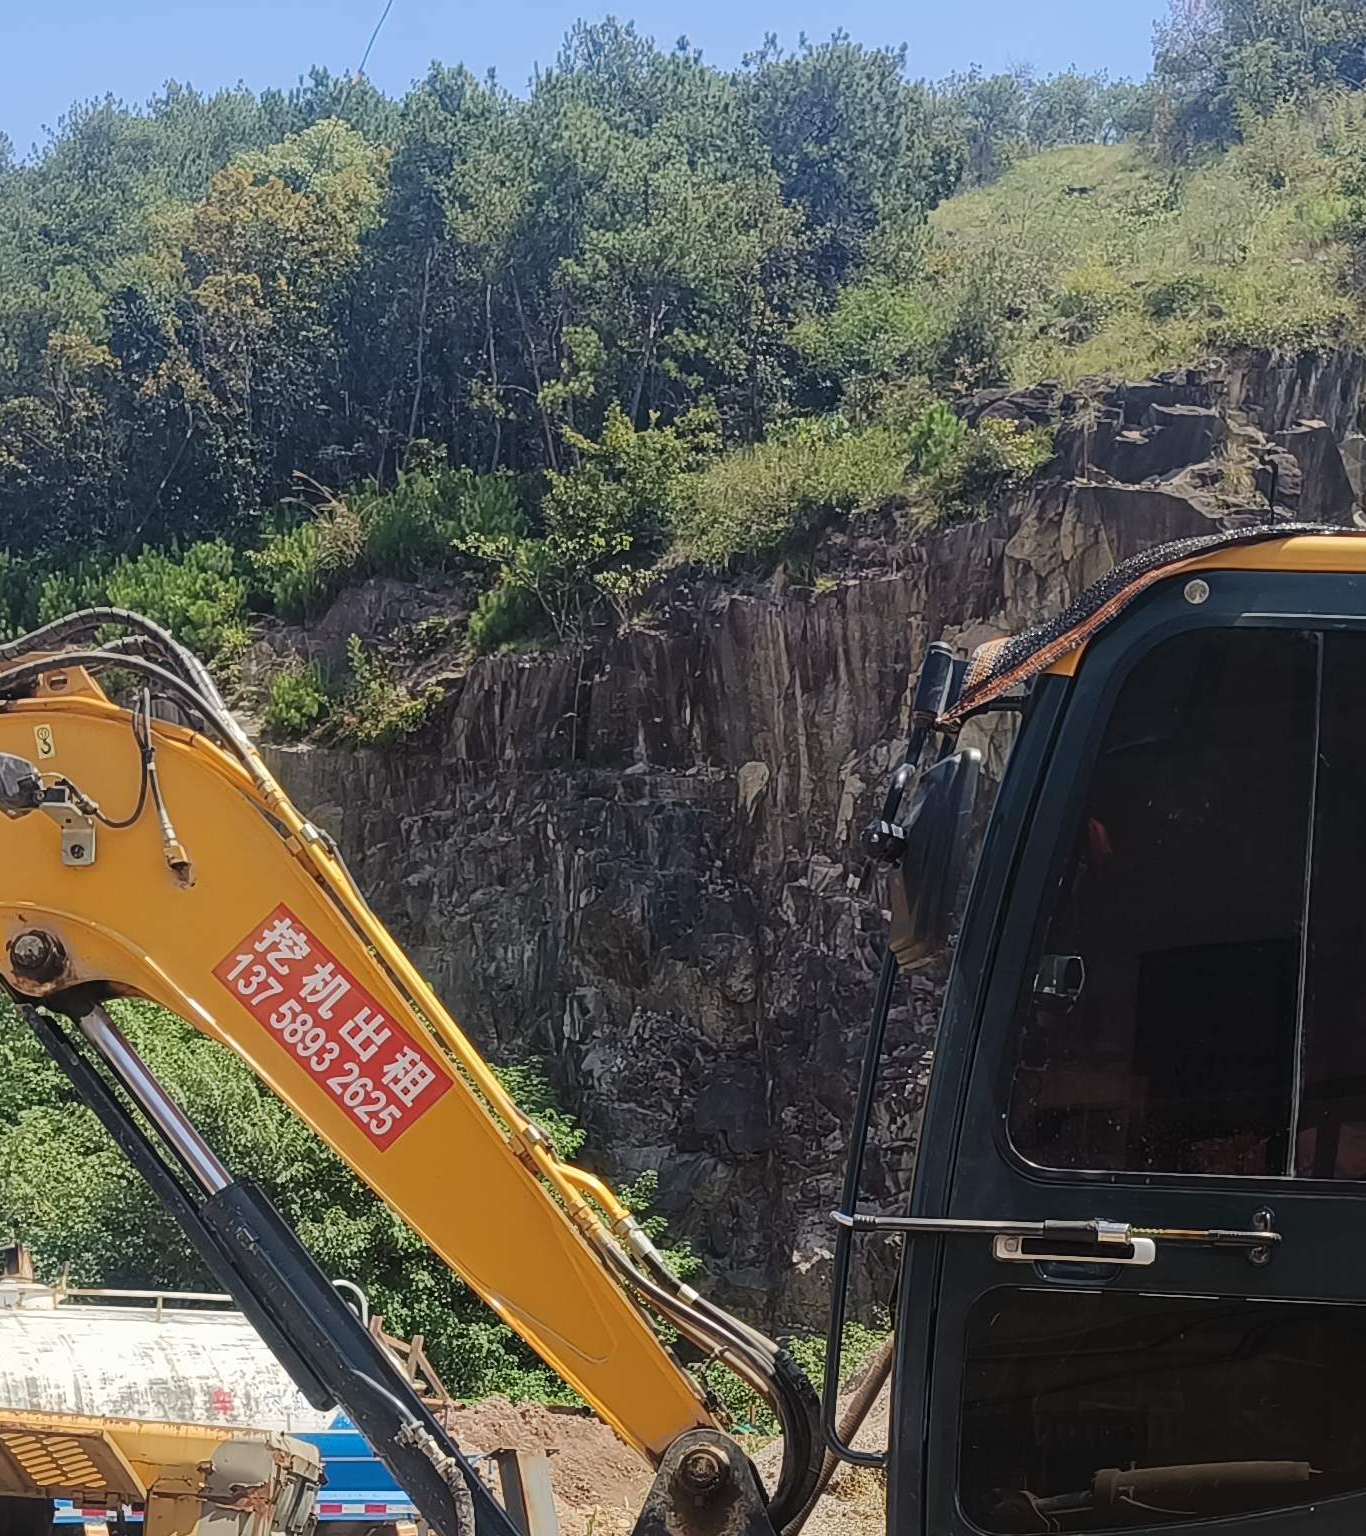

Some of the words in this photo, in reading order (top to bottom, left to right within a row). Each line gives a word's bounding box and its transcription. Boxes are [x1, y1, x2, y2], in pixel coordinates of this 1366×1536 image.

[226, 953, 283, 1006] 137
[269, 999, 340, 1072] 5893
[326, 1062, 402, 1136] 2625
[254, 918, 436, 1108] 挖机出租
